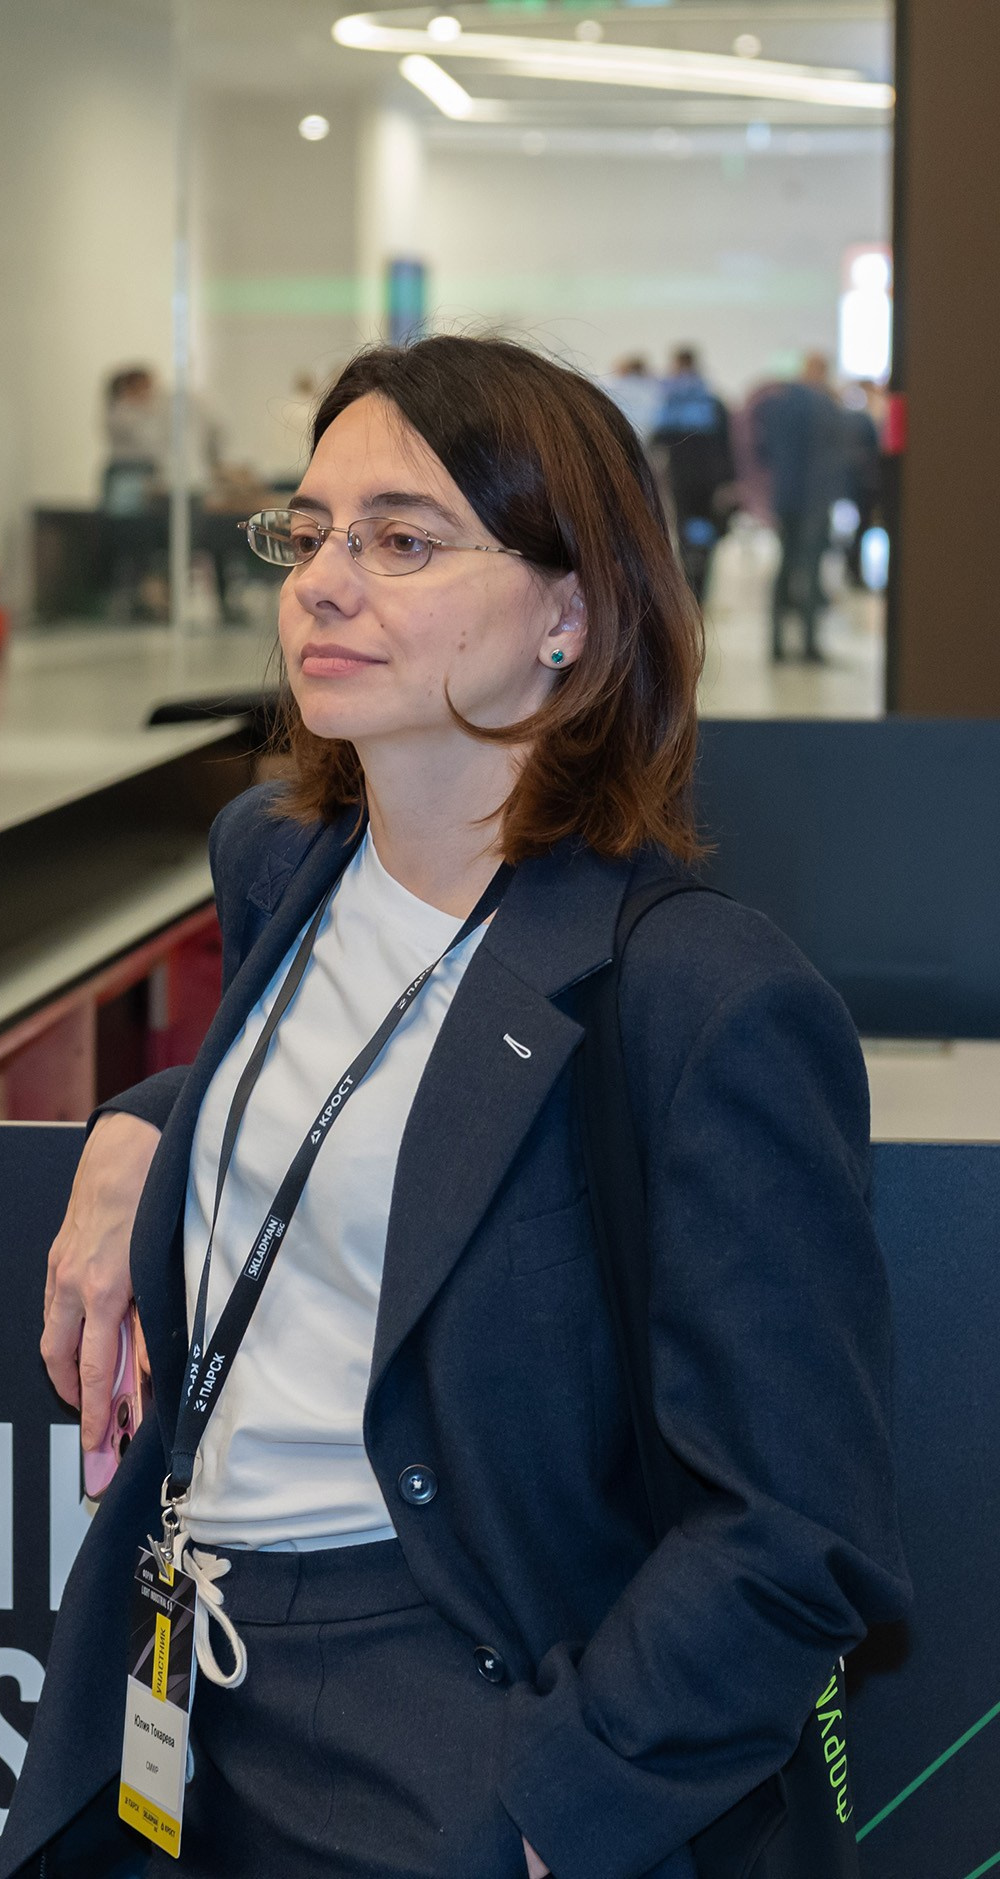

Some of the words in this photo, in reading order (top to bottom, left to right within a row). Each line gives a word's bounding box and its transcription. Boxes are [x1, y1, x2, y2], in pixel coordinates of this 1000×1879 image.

[318, 1074, 354, 1127] КРОСТ
[247, 1218, 279, 1277] SKLADMAN
[198, 1351, 226, 1398] ПАРСК
[156, 1627, 166, 1694] УЧАСТНИК
[133, 1713, 150, 1734] Юлия
